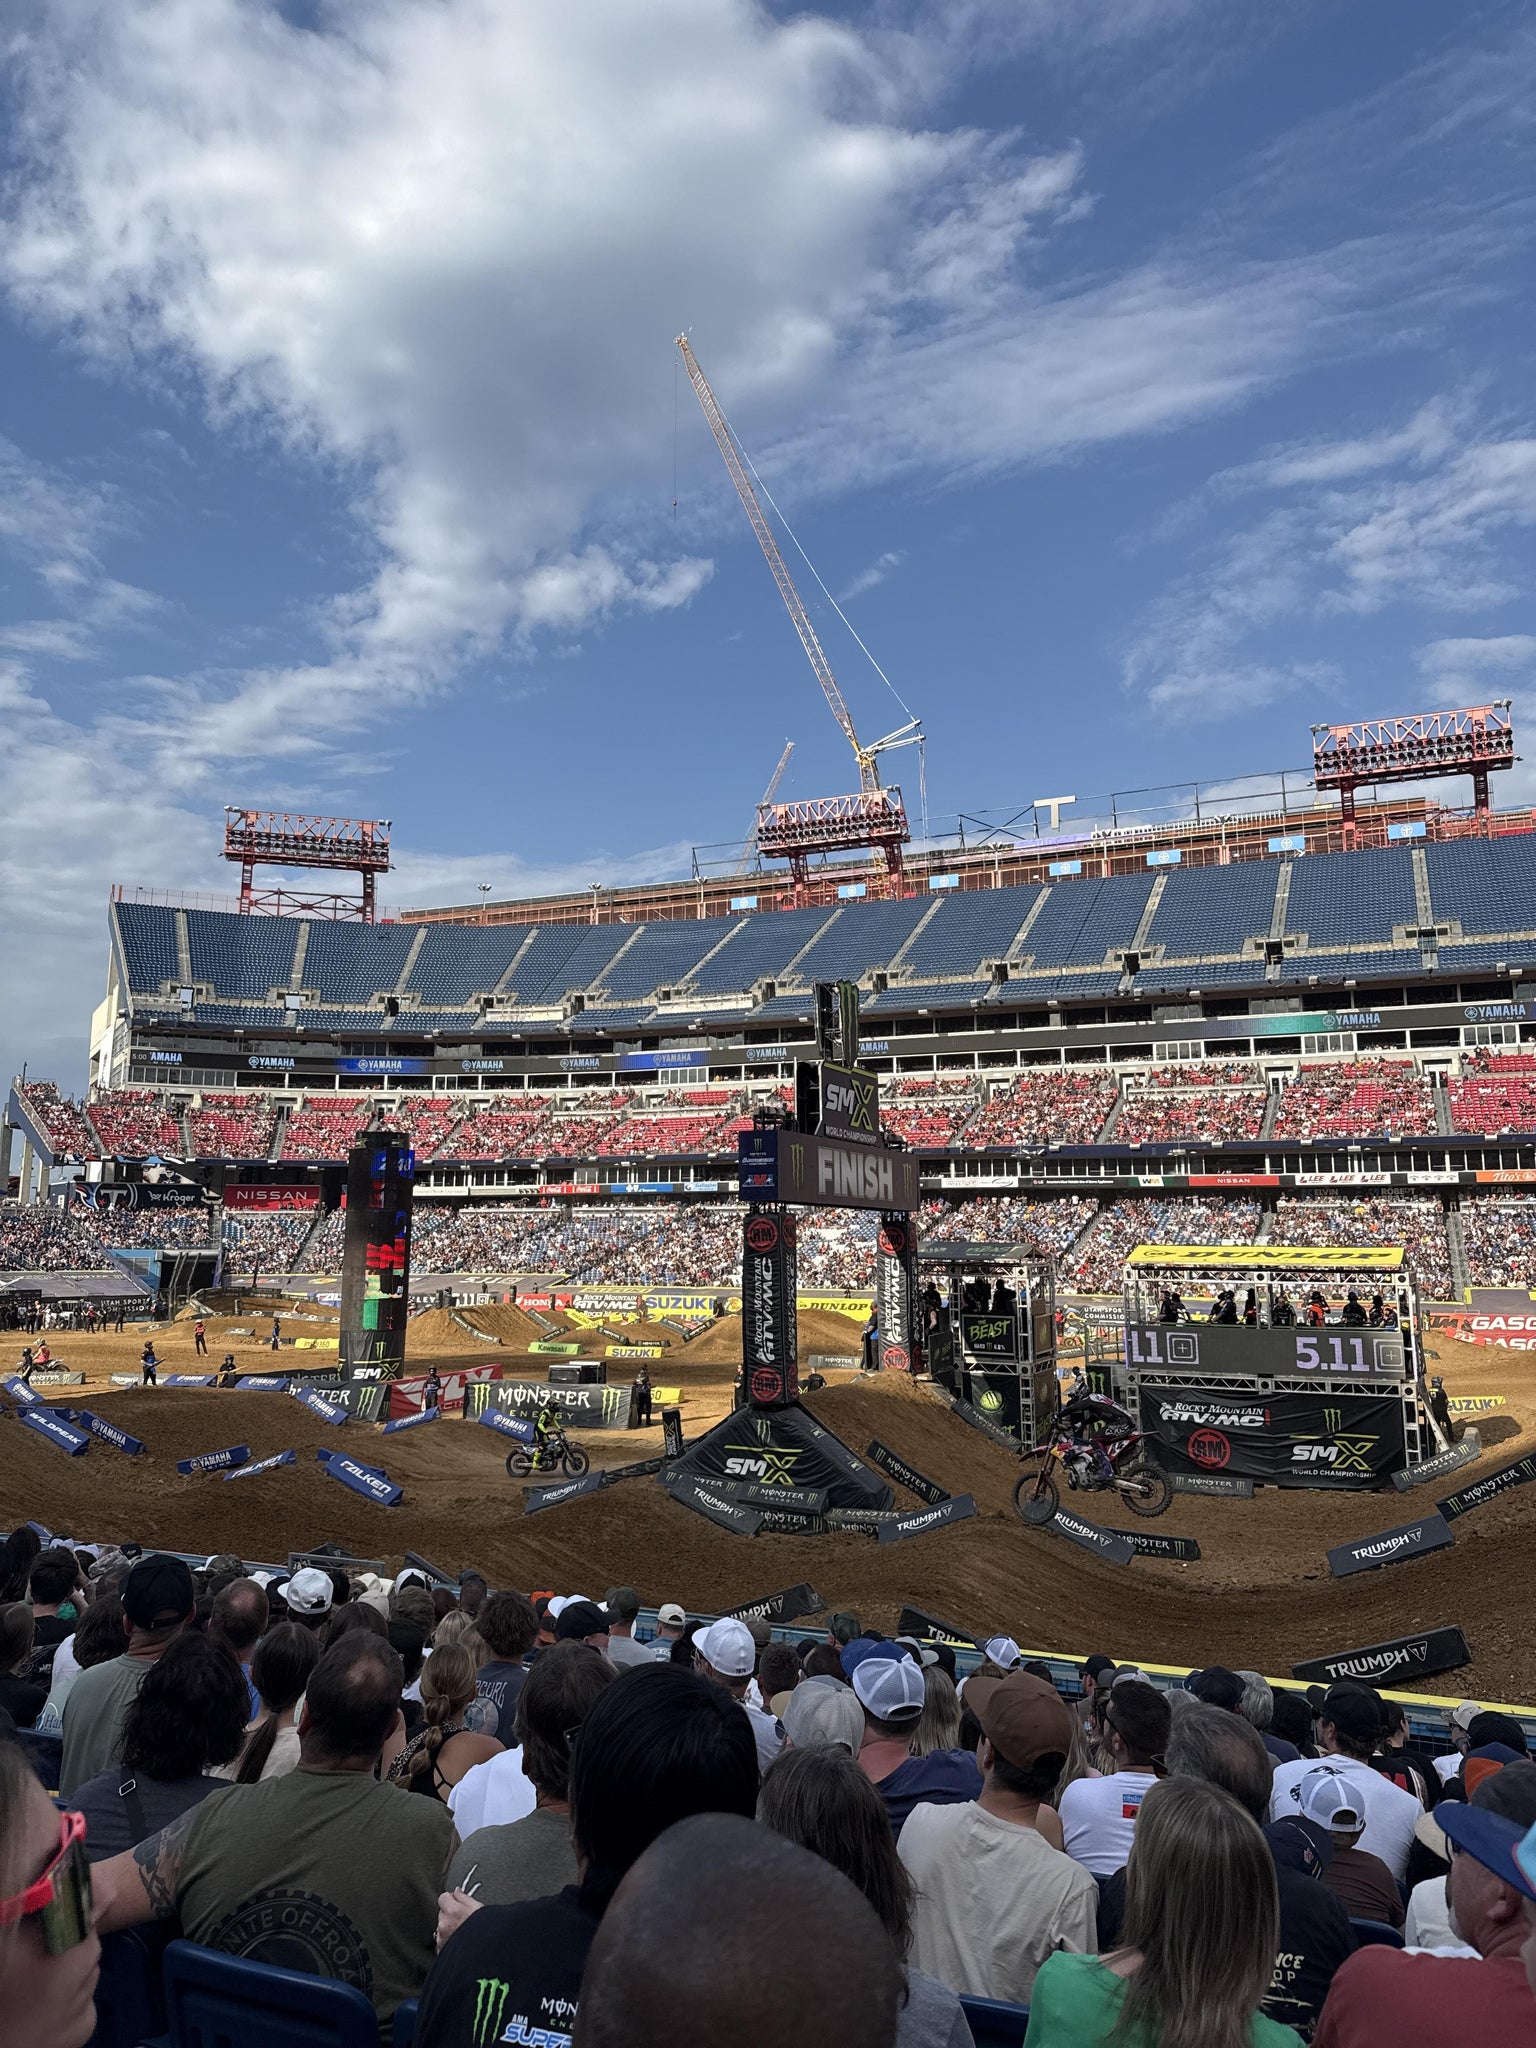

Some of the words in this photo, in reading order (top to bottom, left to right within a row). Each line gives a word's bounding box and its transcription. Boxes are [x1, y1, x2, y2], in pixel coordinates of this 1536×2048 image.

[1336, 1013, 1381, 1025] YAMAHA
[1479, 1005, 1526, 1018] YAMAHA
[150, 1051, 182, 1062] AMAHA
[661, 1053, 691, 1063] YAMAHA
[756, 1047, 787, 1058] YAMAHA
[259, 1057, 295, 1067] YAMAHA
[368, 1060, 402, 1070] YAMAHA
[471, 1059, 504, 1070] YAMAHA
[568, 1057, 600, 1068] YAMAHA
[825, 1079, 874, 1131] SMX
[826, 1125, 842, 1137] WORLD
[843, 1129, 877, 1143] CHAMPIONSHIP
[817, 1146, 893, 1201] FINISH
[1493, 1172, 1520, 1181] Tito's
[162, 1190, 195, 1206] Kroger
[236, 1190, 307, 1200] NISSAN
[1314, 1188, 1338, 1196] ELVIN
[1177, 1251, 1392, 1260] DUNLOP
[885, 1258, 894, 1304] MOUNTAIN
[523, 1298, 563, 1307] HONA
[645, 1297, 714, 1310] SUZUKI
[810, 1302, 868, 1311] DUNLOP
[755, 1311, 763, 1345] ROCKY
[969, 1320, 1010, 1342] BEAST
[538, 1344, 568, 1353] Kawasaki
[612, 1348, 654, 1358] SUZUKI
[1296, 1336, 1370, 1372] 5.11
[352, 1363, 400, 1380] SMX
[498, 1385, 591, 1408] MONSTER
[314, 1398, 336, 1417] YAMAHA
[509, 1409, 574, 1420] ENEGY
[1175, 1402, 1207, 1413] ROCKY
[1208, 1405, 1264, 1415] MOUNTAIN
[29, 1412, 82, 1444] WILDPEAK
[502, 1416, 528, 1433] YAMAHA
[99, 1420, 127, 1446] YAMAHA
[200, 1451, 232, 1467] YAMAHA
[1290, 1440, 1374, 1471] SMX
[1413, 1451, 1457, 1475] MONSTER
[231, 1454, 283, 1478] FALKEN
[724, 1453, 798, 1486] SMX
[1319, 1469, 1376, 1478] CHAMPIONSHIP
[340, 1460, 392, 1494] FALKEN
[887, 1457, 927, 1492] MONSTER
[1188, 1477, 1233, 1487] MONSTER
[542, 1484, 577, 1501] TRIUMPH
[1463, 1469, 1520, 1502] MONSTER
[1477, 1482, 1517, 1504] ENERGY
[693, 1487, 734, 1514] TRIUMPH
[760, 1488, 805, 1500] MONSTER
[846, 1509, 900, 1519] MONSTER
[896, 1509, 942, 1531] TRIUMPH
[1054, 1512, 1098, 1541] RIUMPH
[1138, 1547, 1162, 1555] ERGY
[1352, 1535, 1409, 1560] TRIUMPH
[728, 1602, 772, 1621] IUMPH
[1325, 1648, 1410, 1679] TRIUMPH
[222, 1908, 274, 1952] NITE
[511, 2014, 529, 2025] AMA
[549, 2018, 576, 2030] ENE
